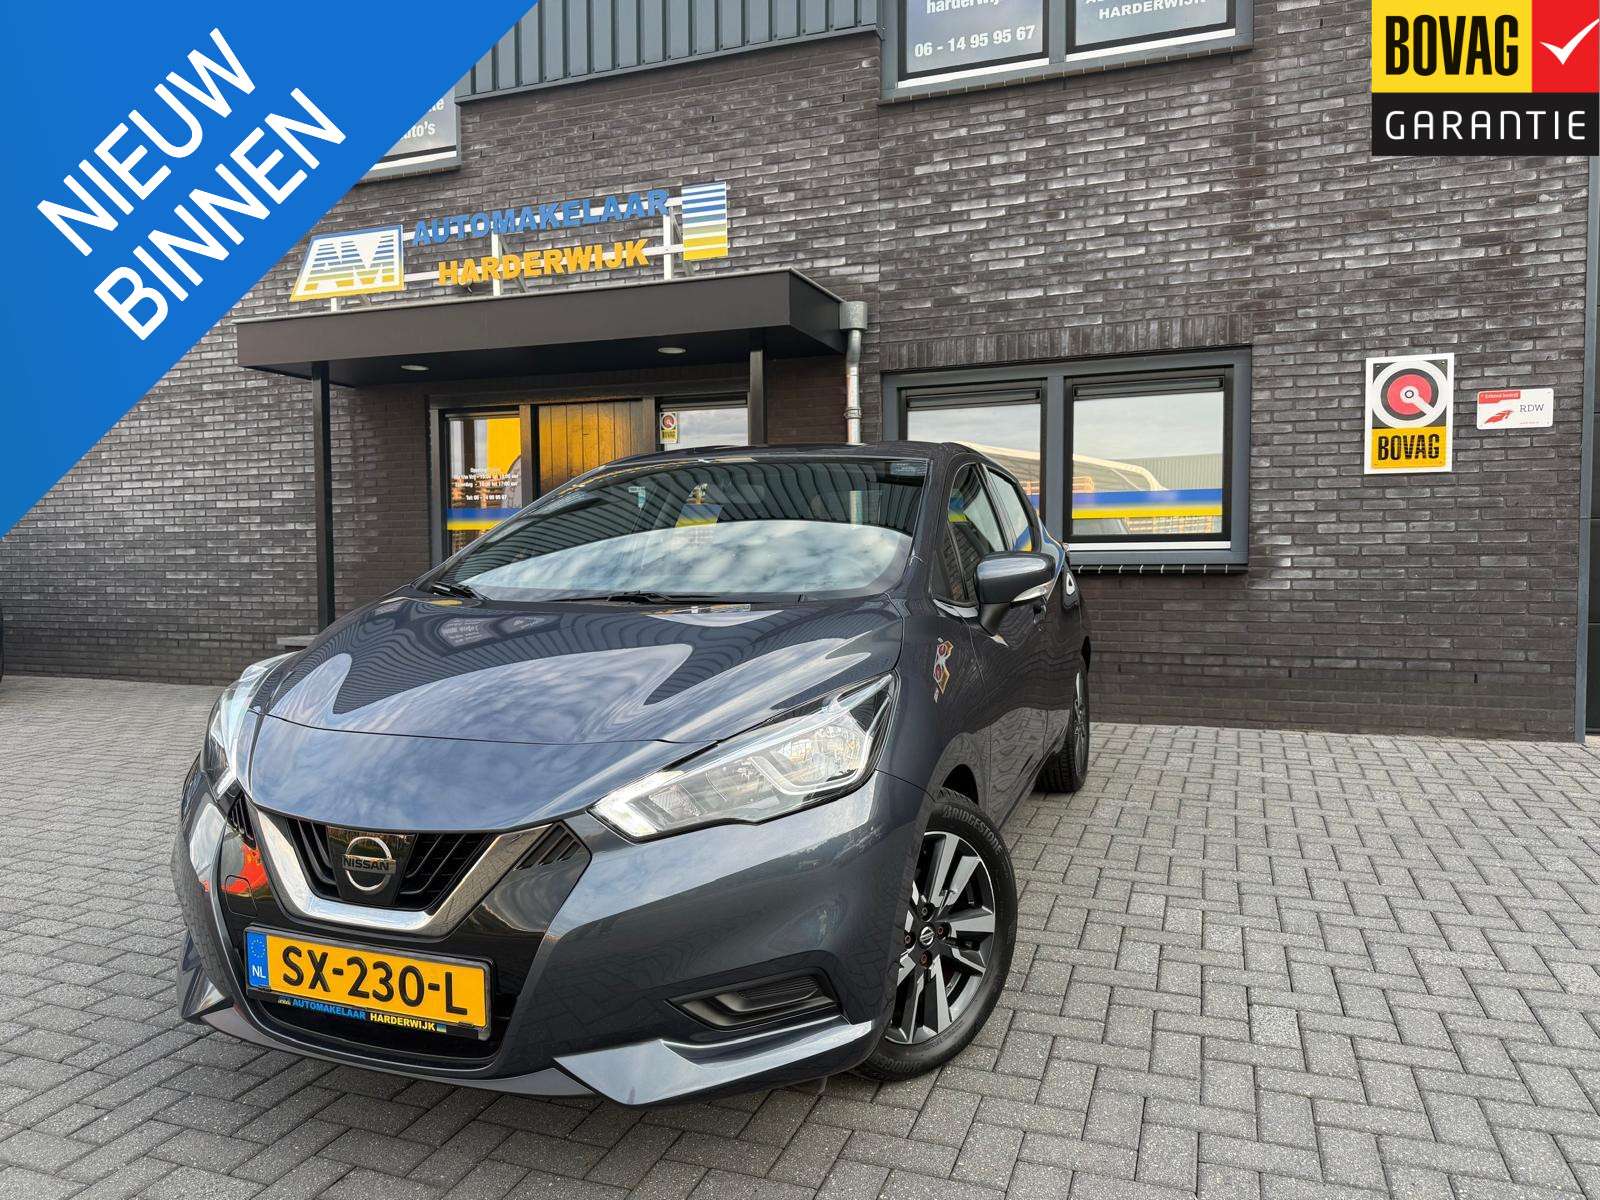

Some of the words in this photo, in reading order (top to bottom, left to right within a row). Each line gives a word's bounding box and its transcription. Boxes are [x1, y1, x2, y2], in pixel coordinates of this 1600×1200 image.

[914, 42, 932, 57] 06
[948, 37, 966, 52] 14
[970, 33, 988, 49] 95
[993, 29, 1011, 44] 95
[1016, 25, 1035, 41] 67
[412, 188, 670, 247] AUTOMAKELAAR
[438, 239, 650, 285] HARDERWIJK
[1520, 403, 1545, 413] RDW
[1377, 433, 1440, 461] BOVAG
[943, 805, 1003, 856] BRIDGESTONE
[343, 856, 390, 871] NISSAN
[252, 965, 266, 979] NL
[282, 945, 468, 1016] SX-230-L
[292, 998, 366, 1021] AUTOMAKELAAR
[370, 1013, 436, 1031] HARDERWIJK
